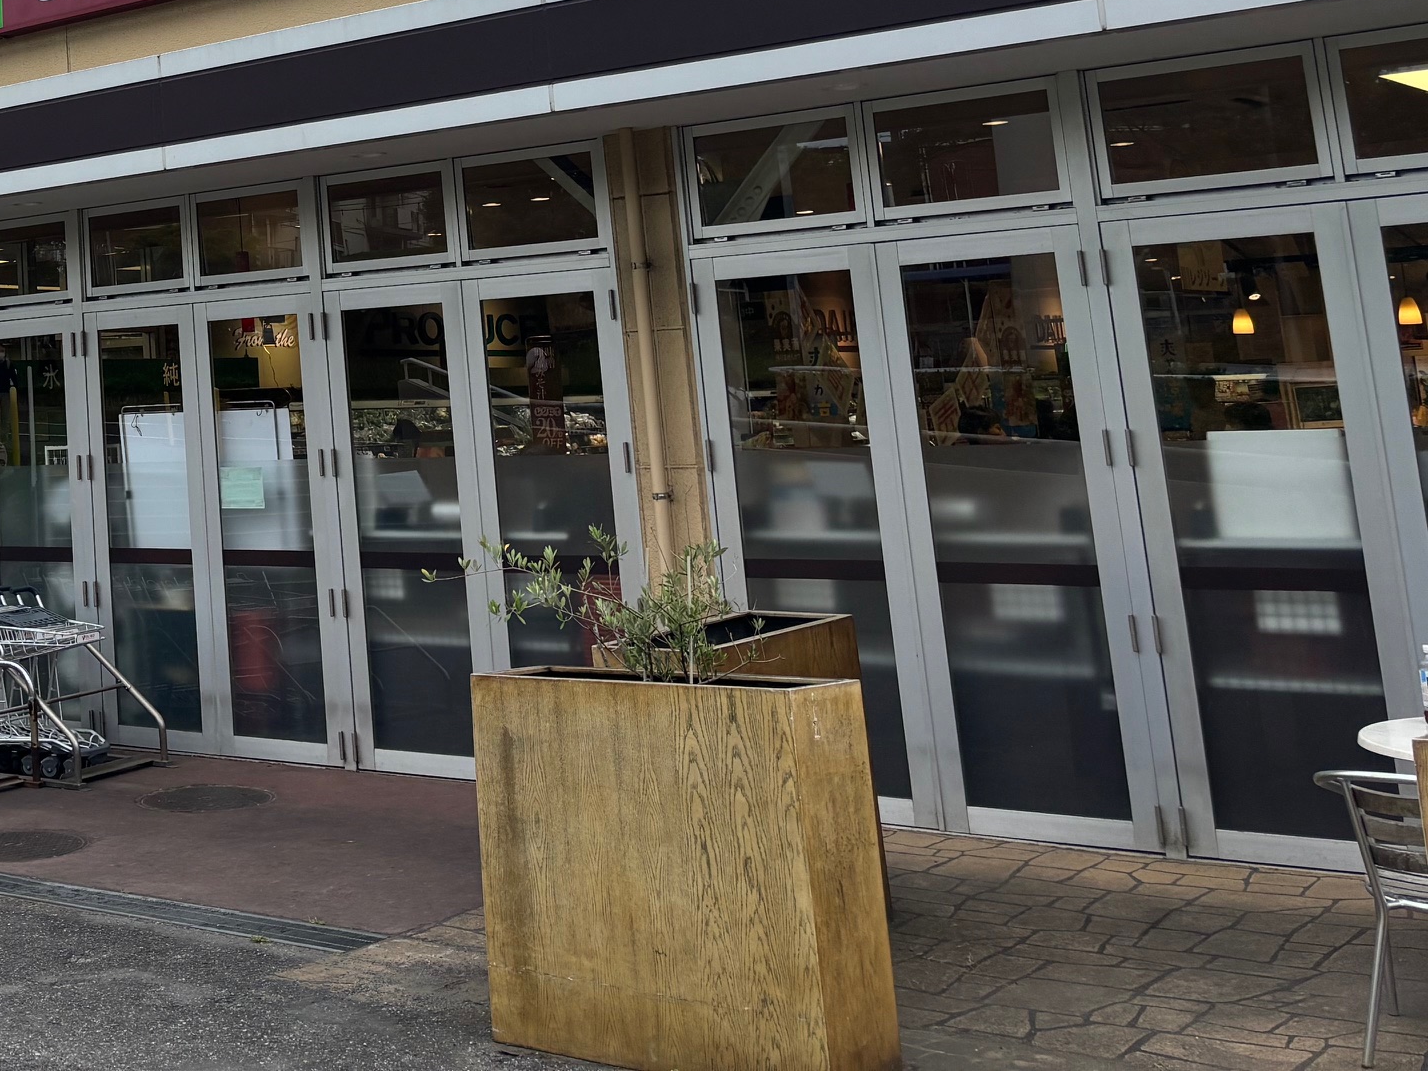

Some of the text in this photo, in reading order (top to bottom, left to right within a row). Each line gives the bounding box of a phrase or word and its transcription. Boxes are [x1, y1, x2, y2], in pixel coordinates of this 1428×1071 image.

[275, 328, 295, 347] the
[42, 363, 61, 390] 氷
[162, 362, 180, 387] 純
